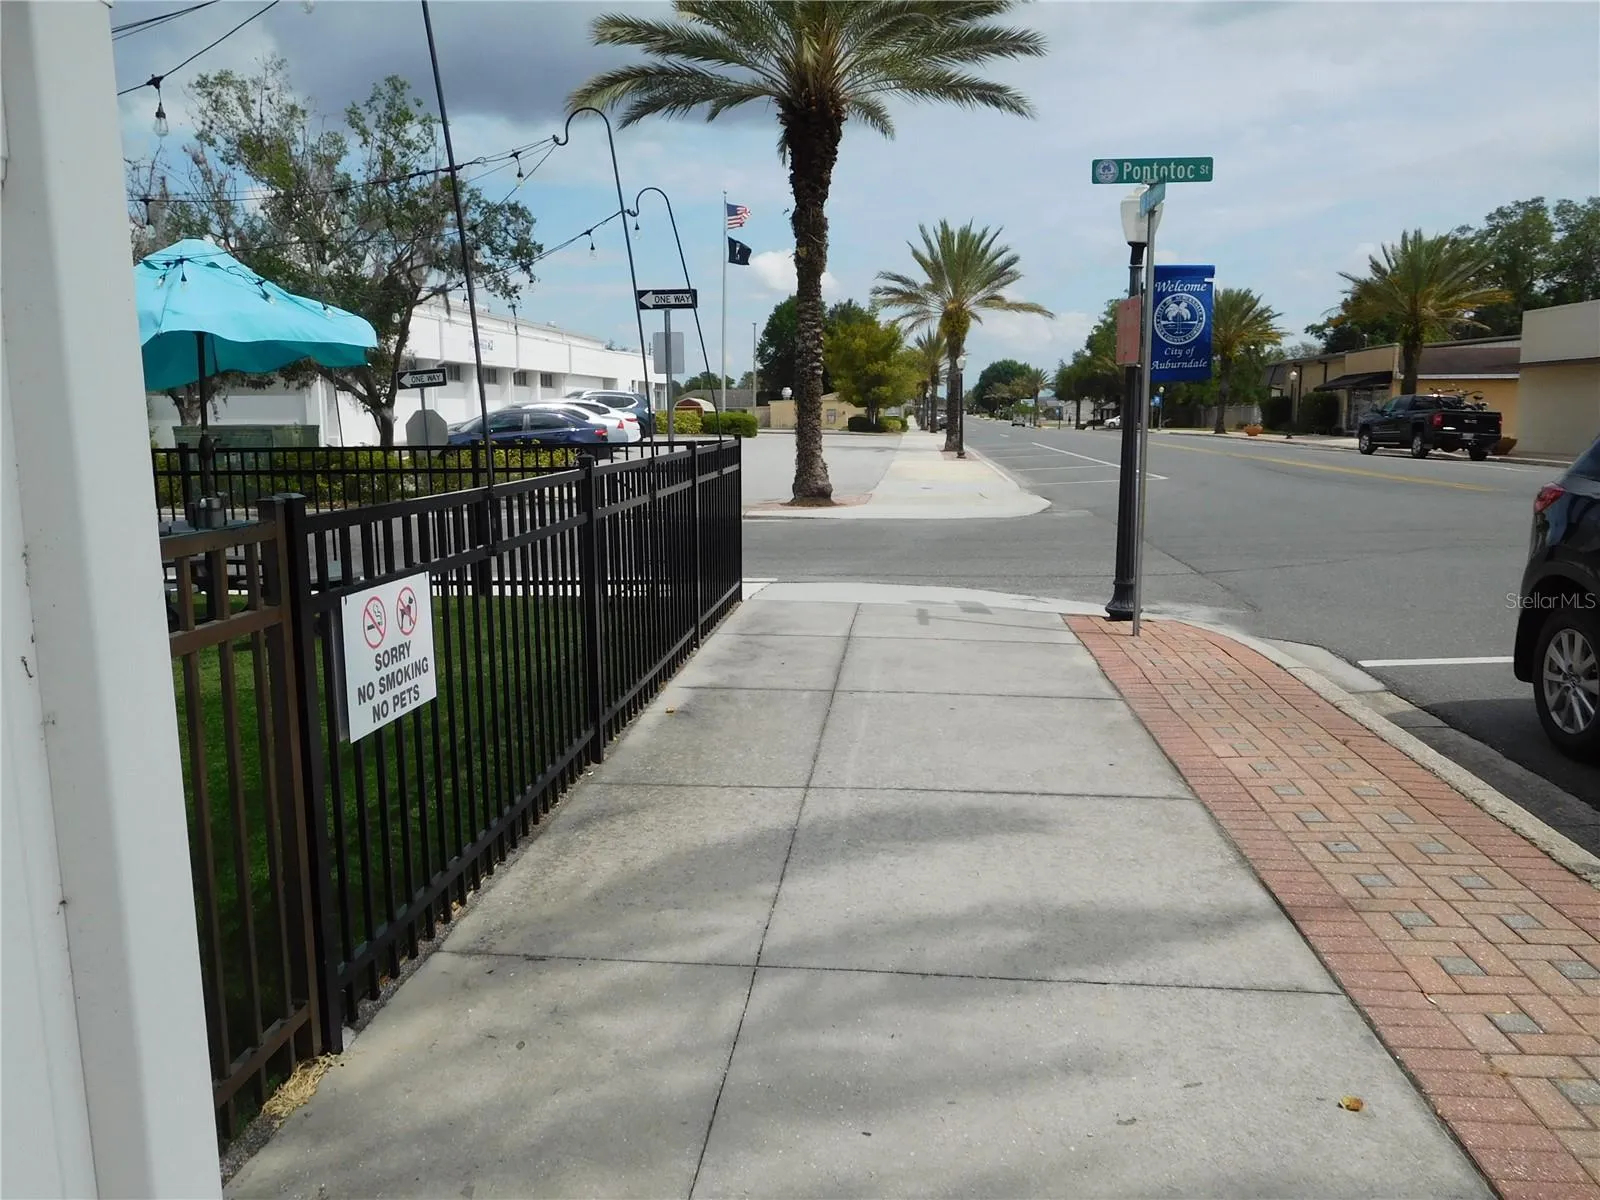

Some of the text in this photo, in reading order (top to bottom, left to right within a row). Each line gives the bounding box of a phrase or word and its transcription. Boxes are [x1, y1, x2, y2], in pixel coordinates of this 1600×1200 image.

[1124, 161, 1210, 180] Pontotoc St
[1155, 280, 1207, 292] Welcome
[654, 295, 690, 303] ONE WAY
[1166, 346, 1195, 357] City of
[1151, 359, 1207, 369] Auburndale
[411, 374, 440, 383] ONE WAY
[374, 640, 412, 672] SORRY
[357, 657, 429, 706] NO SMOKING
[372, 684, 420, 724] NO PETS
